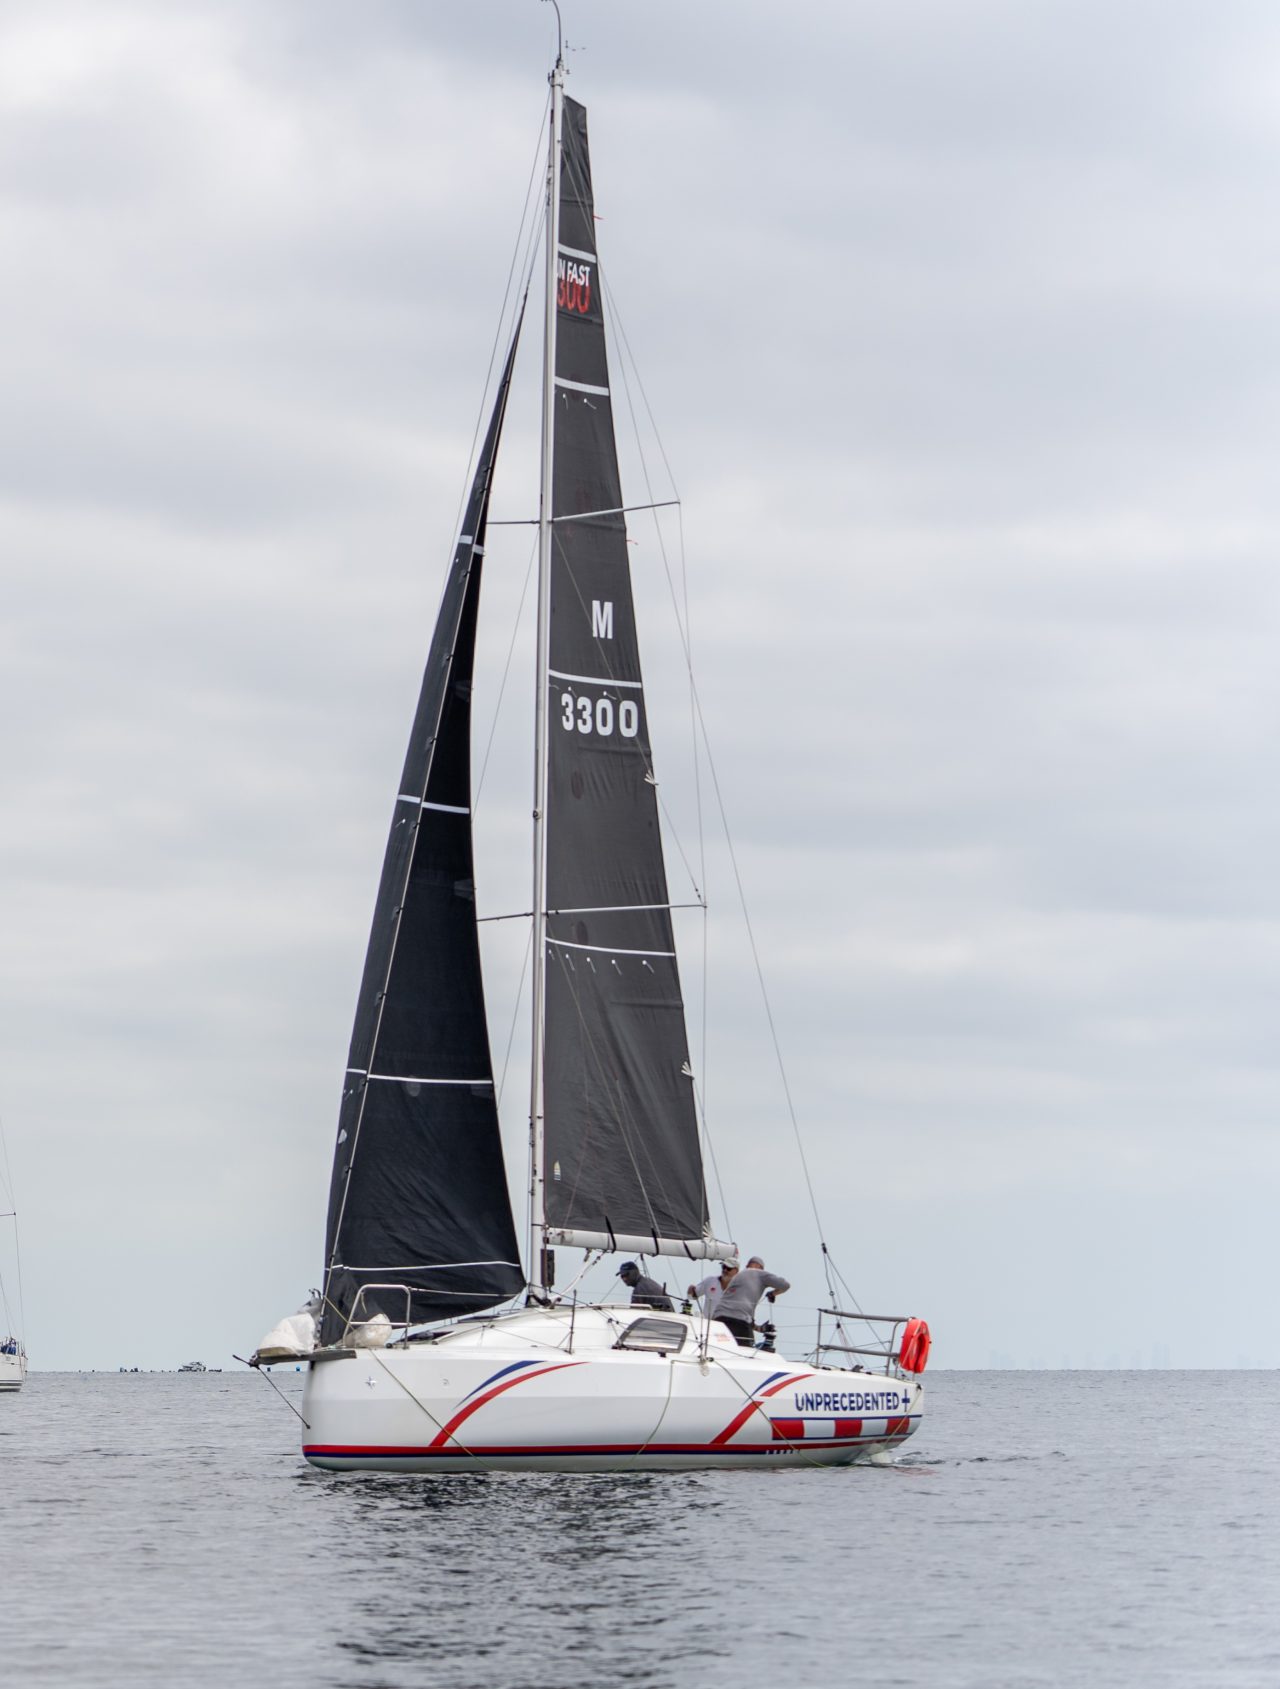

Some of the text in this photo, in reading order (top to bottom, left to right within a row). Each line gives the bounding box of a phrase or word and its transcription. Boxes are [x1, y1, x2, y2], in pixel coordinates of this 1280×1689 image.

[566, 261, 591, 287] FAST
[591, 600, 614, 640] M
[560, 693, 639, 738] 3300
[794, 1391, 900, 1412] UNPRECEDENTED
